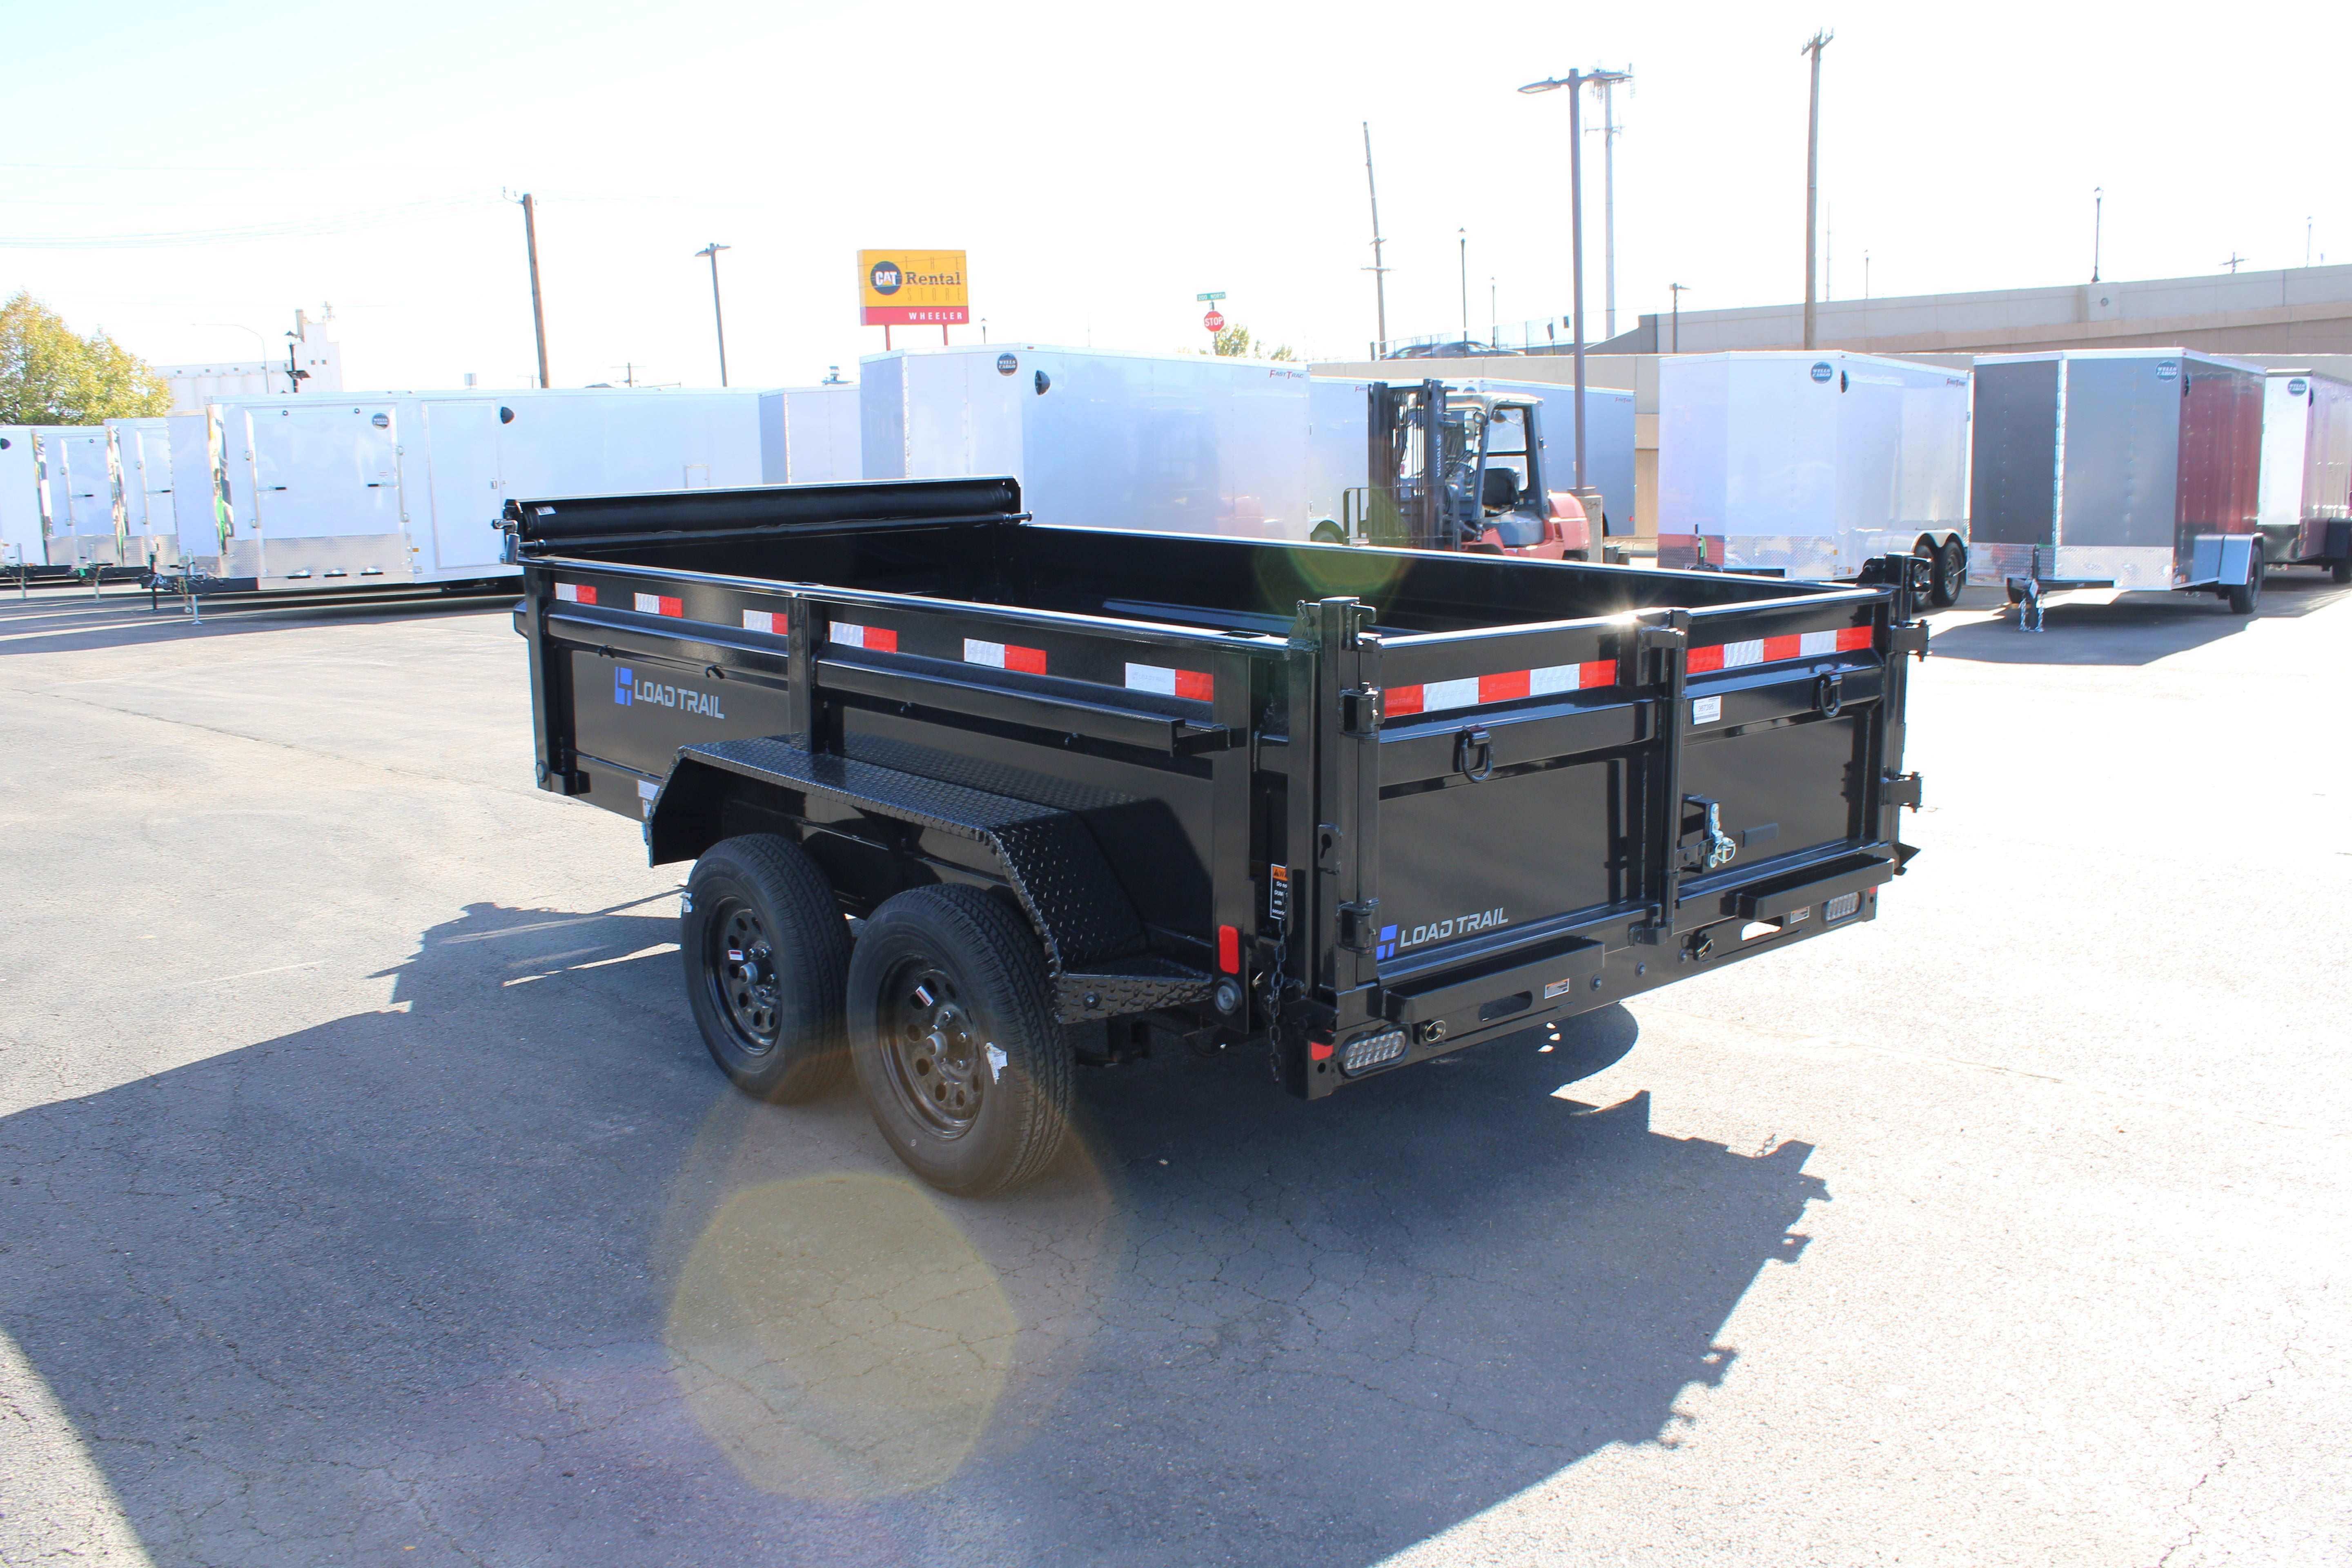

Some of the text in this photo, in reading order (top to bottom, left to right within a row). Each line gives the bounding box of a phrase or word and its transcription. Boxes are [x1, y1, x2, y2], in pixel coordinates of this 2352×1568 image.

[905, 256, 959, 270] THE
[875, 271, 898, 286] CAT
[905, 272, 961, 285] Rental
[909, 312, 962, 320] WHEELER
[1205, 316, 1223, 327] STOP
